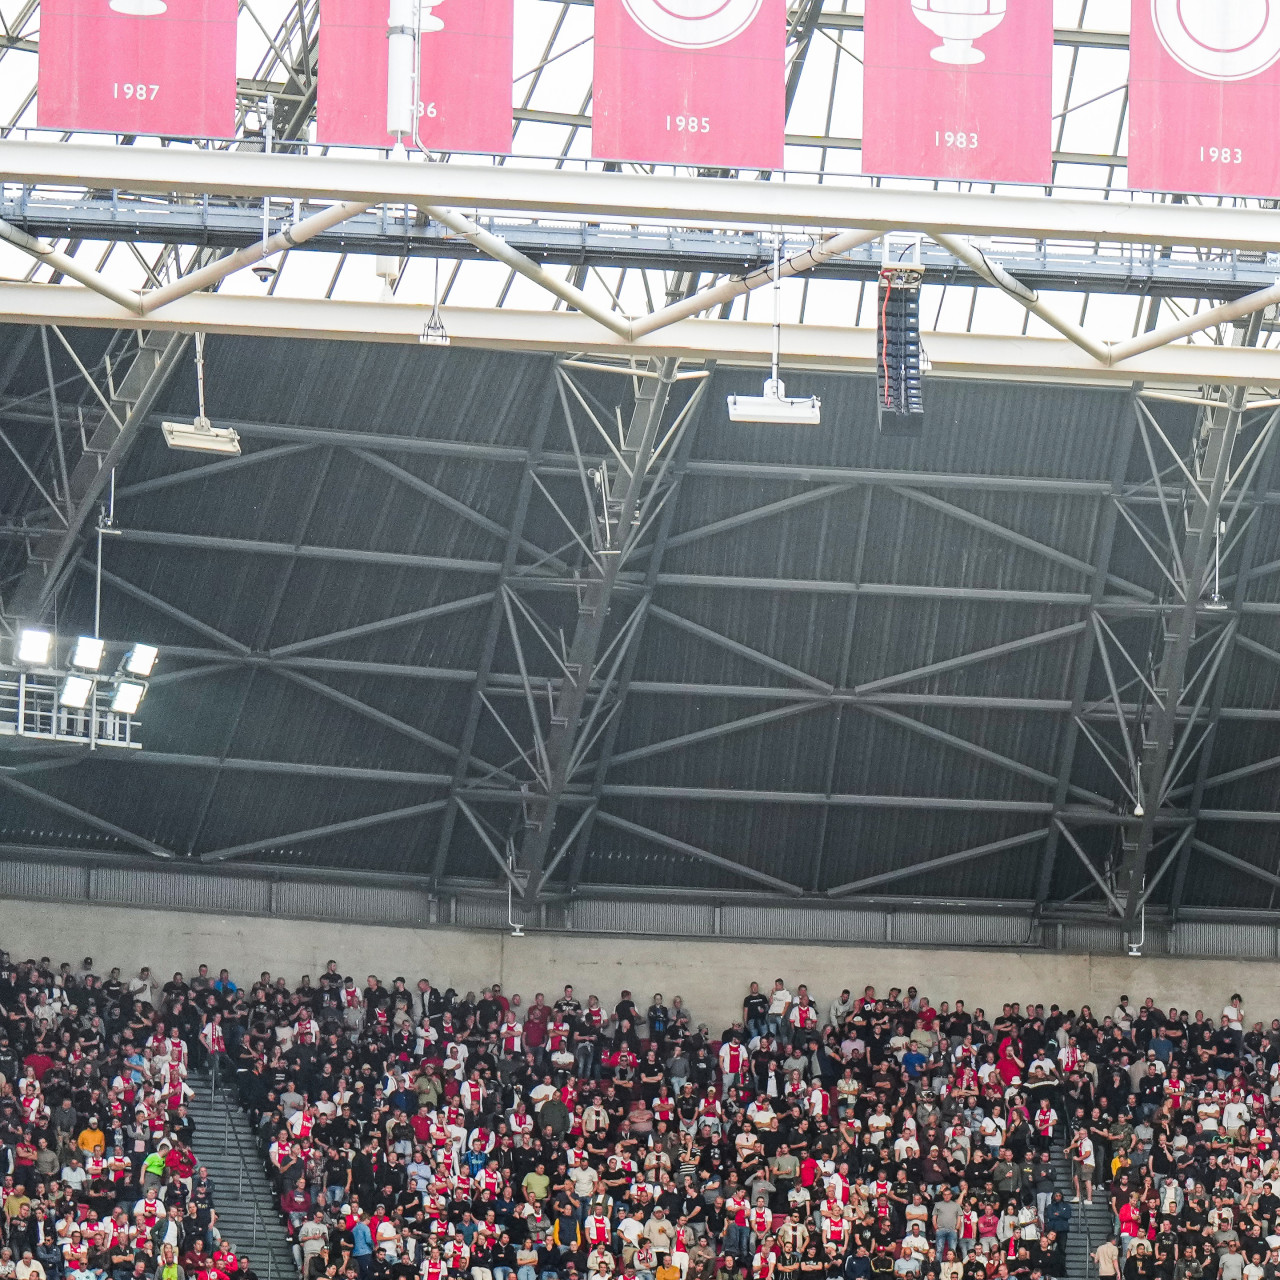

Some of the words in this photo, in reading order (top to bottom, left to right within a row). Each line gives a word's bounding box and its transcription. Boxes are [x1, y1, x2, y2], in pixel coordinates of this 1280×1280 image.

[113, 82, 160, 101] 1987
[666, 115, 710, 133] 1985
[935, 130, 979, 148] 1983
[1200, 146, 1243, 164] 1983
